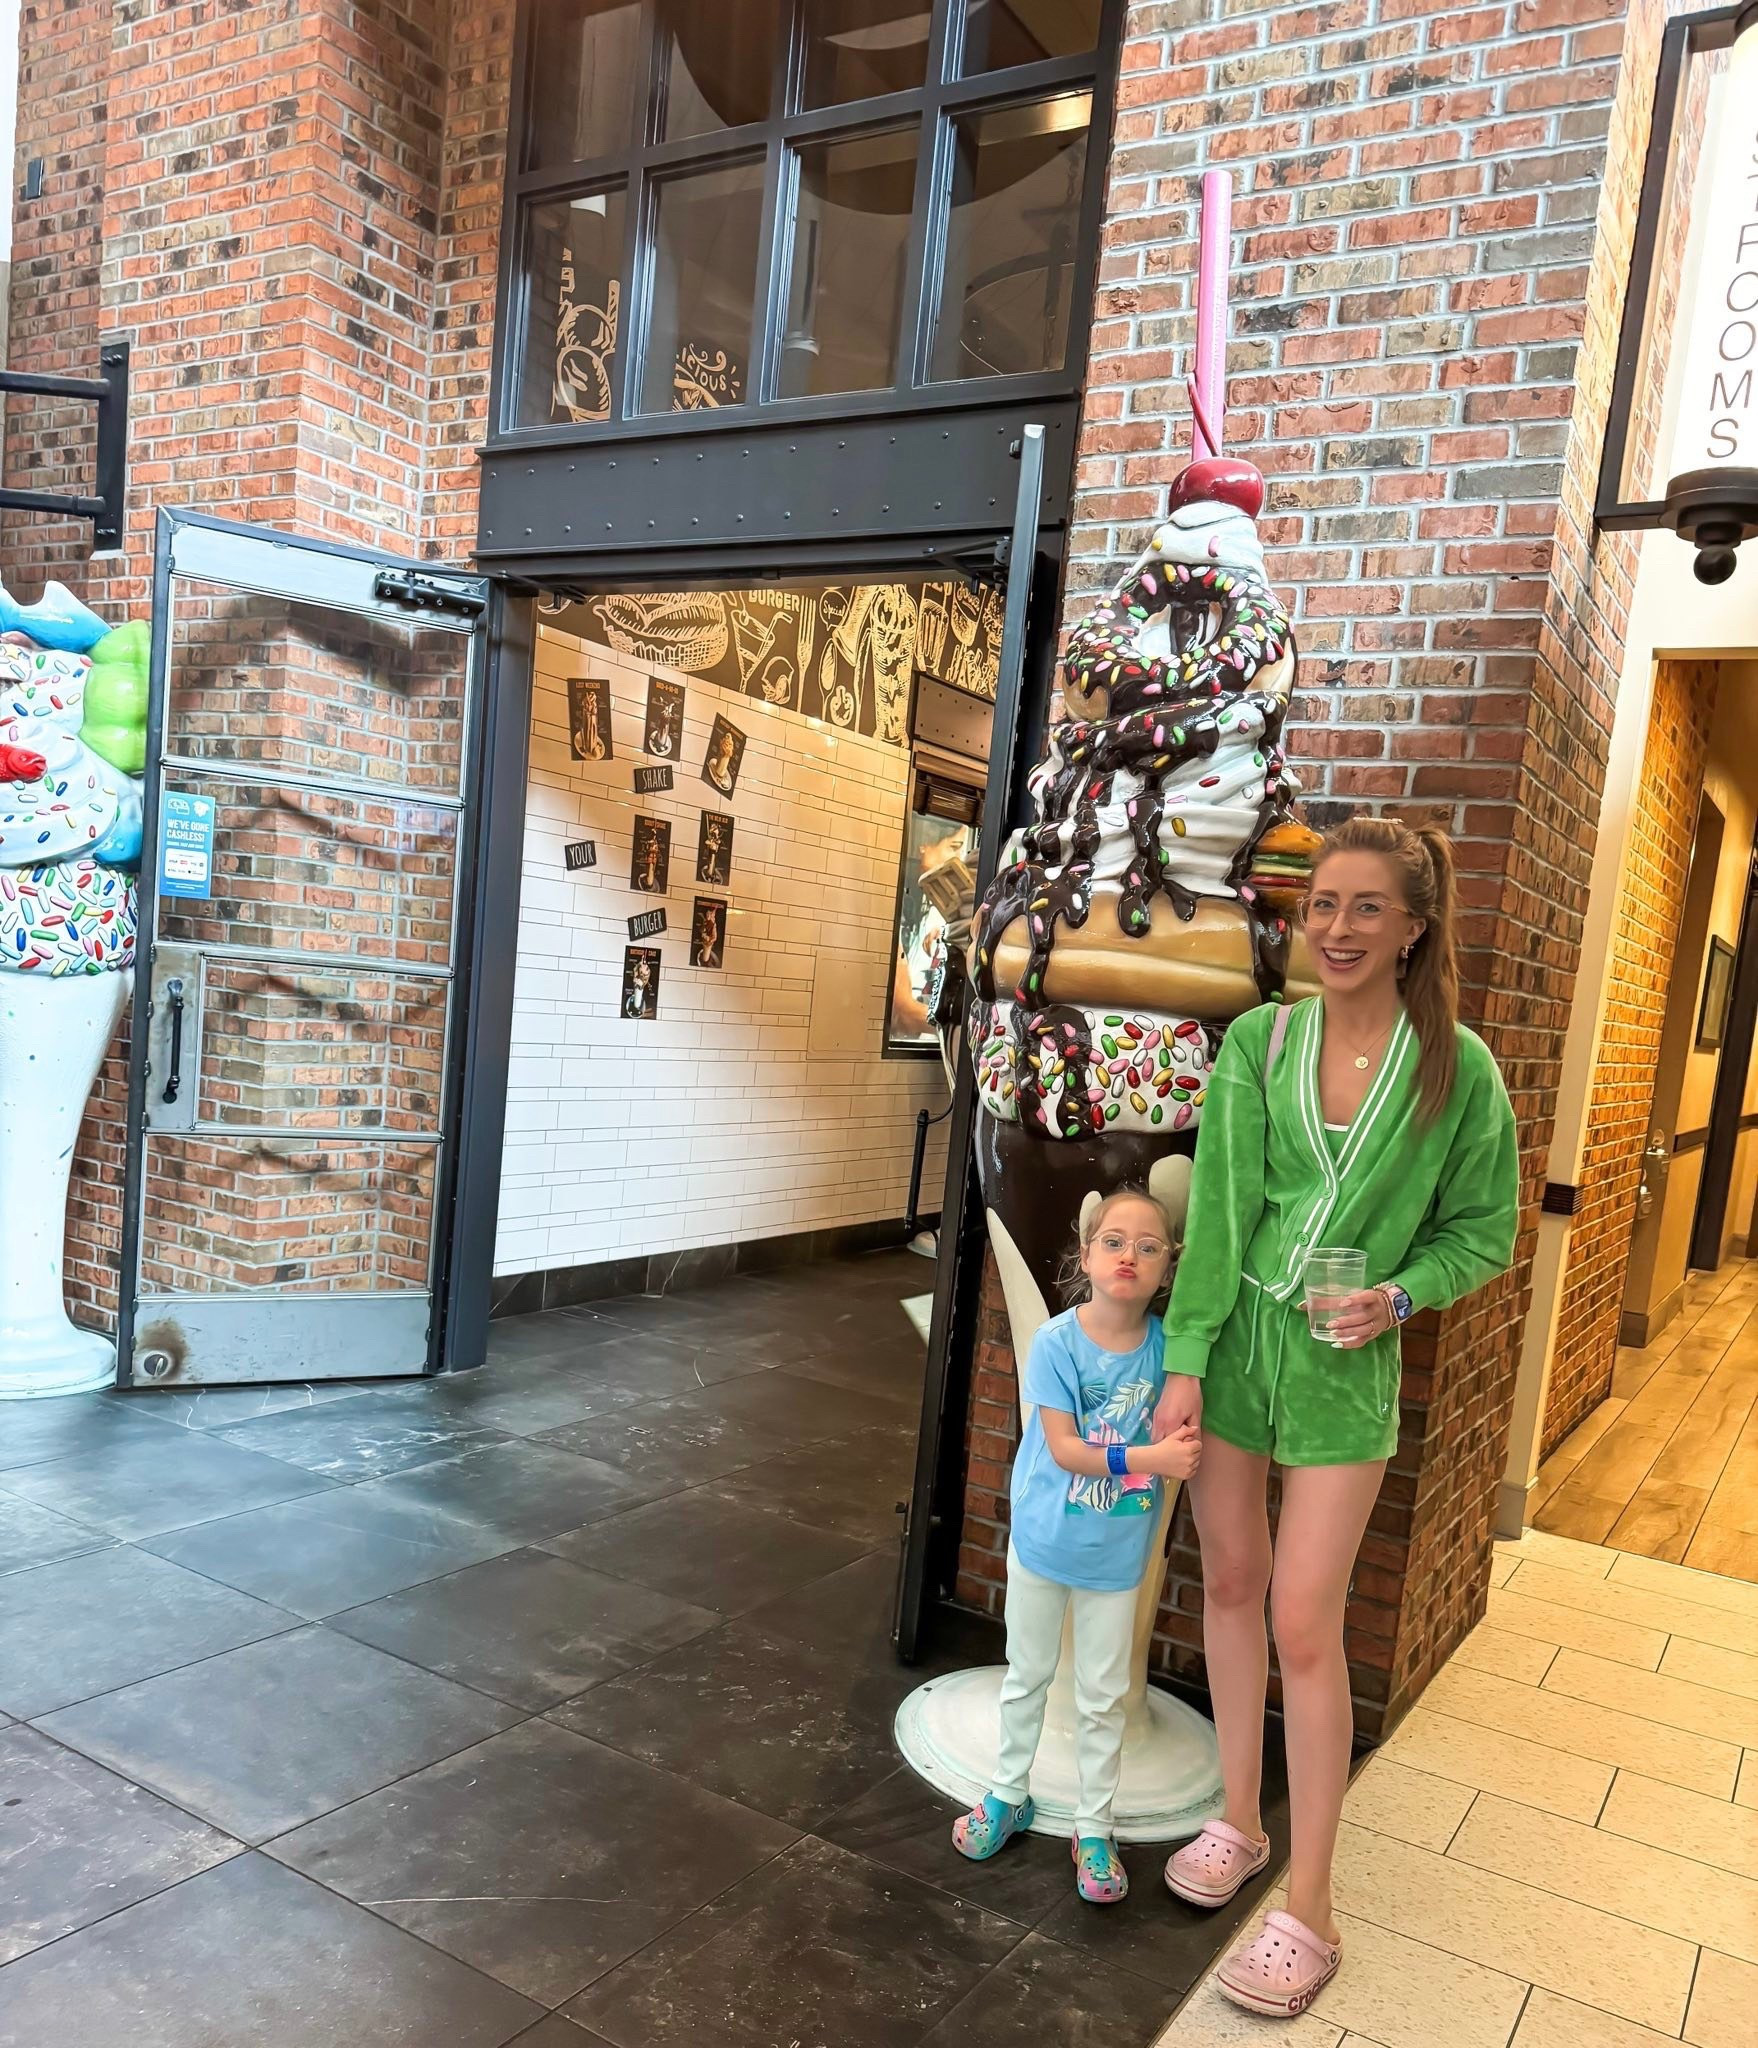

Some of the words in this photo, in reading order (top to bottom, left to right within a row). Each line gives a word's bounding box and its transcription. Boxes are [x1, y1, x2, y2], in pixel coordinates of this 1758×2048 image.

[748, 589, 800, 613] BURGER
[642, 768, 667, 789] SHAKE
[570, 843, 594, 867] YOUR
[633, 911, 664, 937] BURGER
